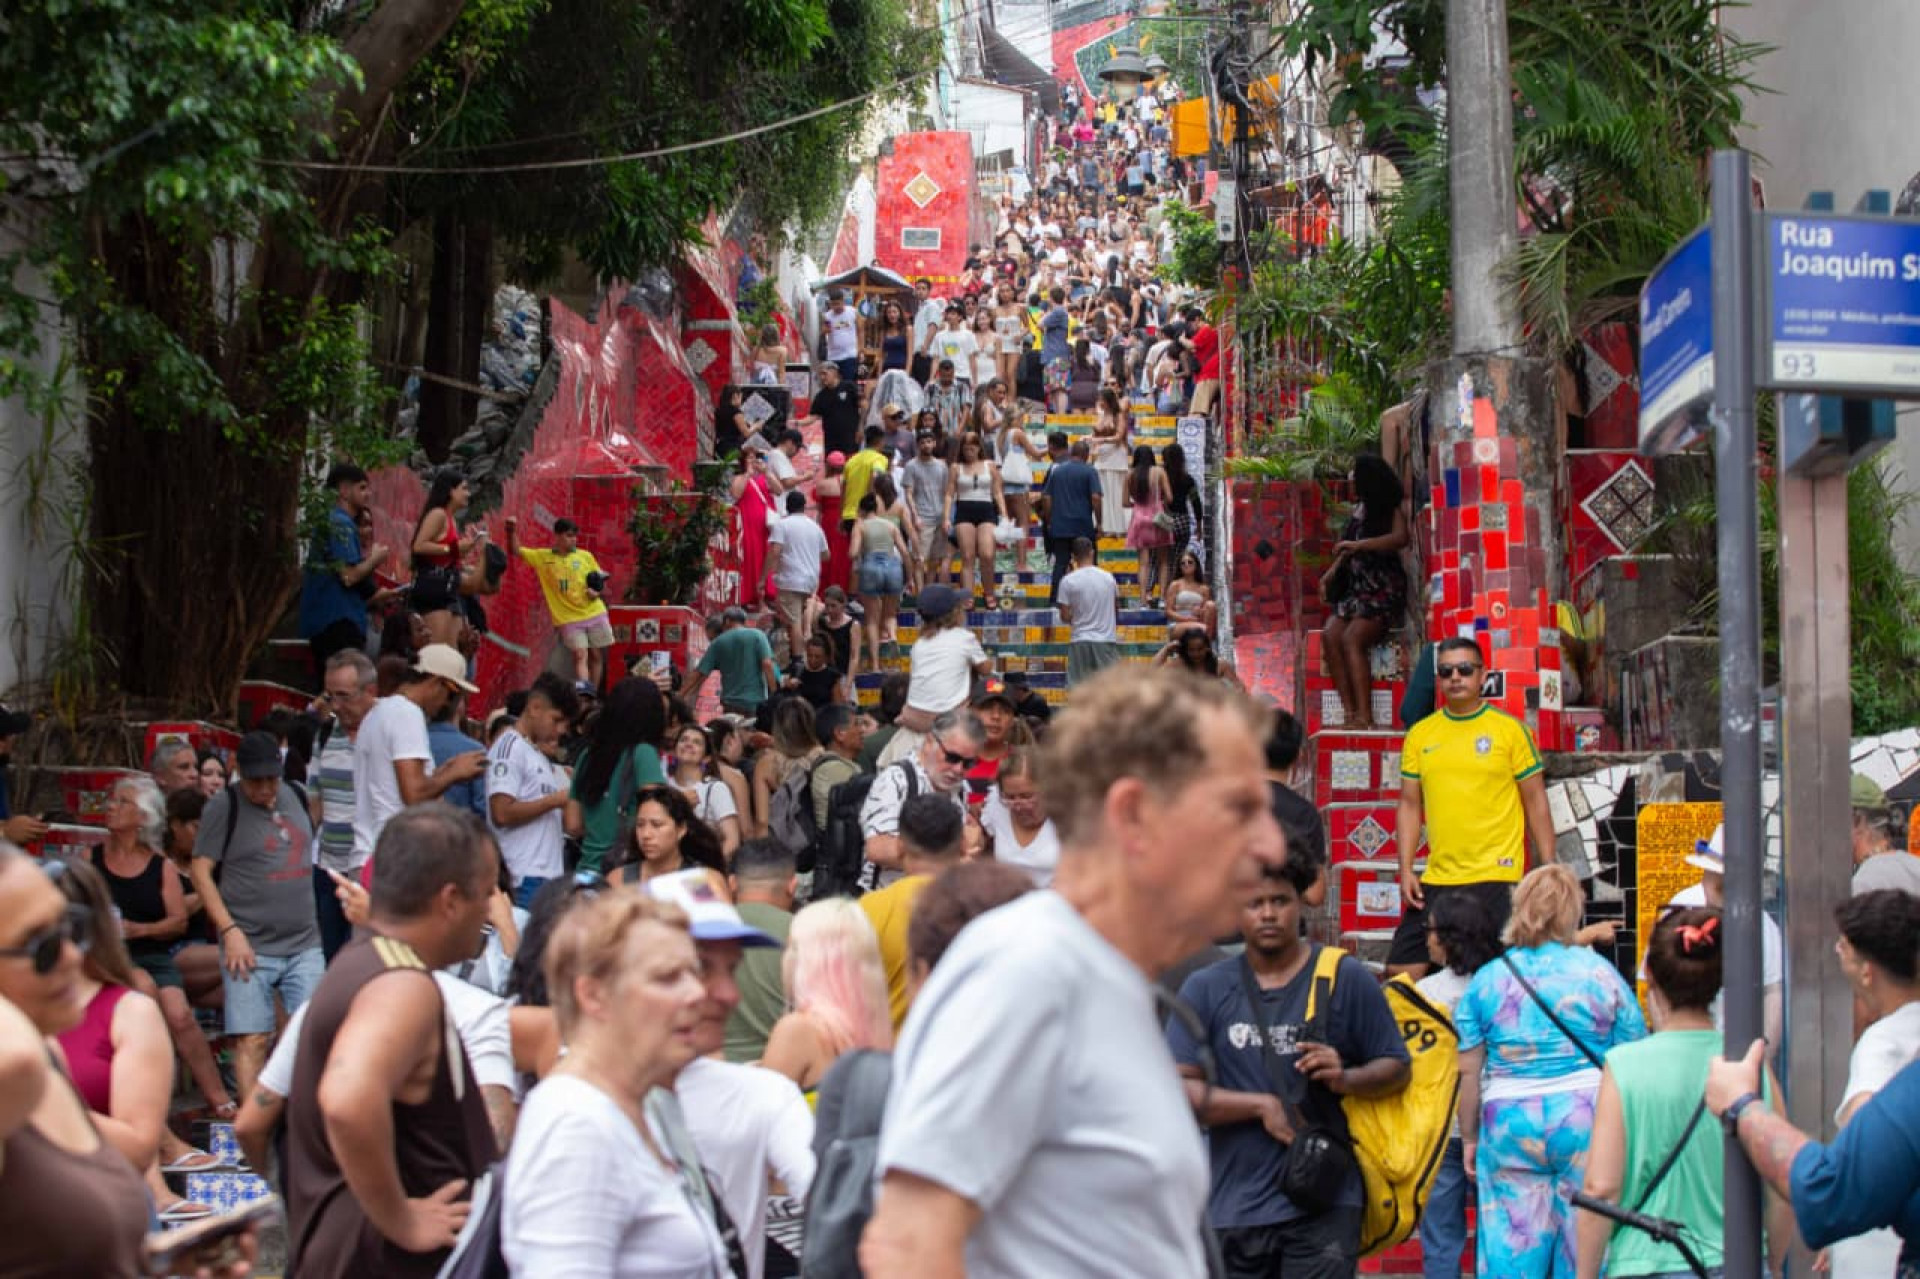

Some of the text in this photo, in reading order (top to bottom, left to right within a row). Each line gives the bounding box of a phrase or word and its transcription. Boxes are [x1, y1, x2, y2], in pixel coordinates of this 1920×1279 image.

[1781, 221, 1833, 247] Rua
[1779, 248, 1896, 282] Joaquim
[1782, 353, 1815, 378] 93
[1403, 1020, 1438, 1052] 99
